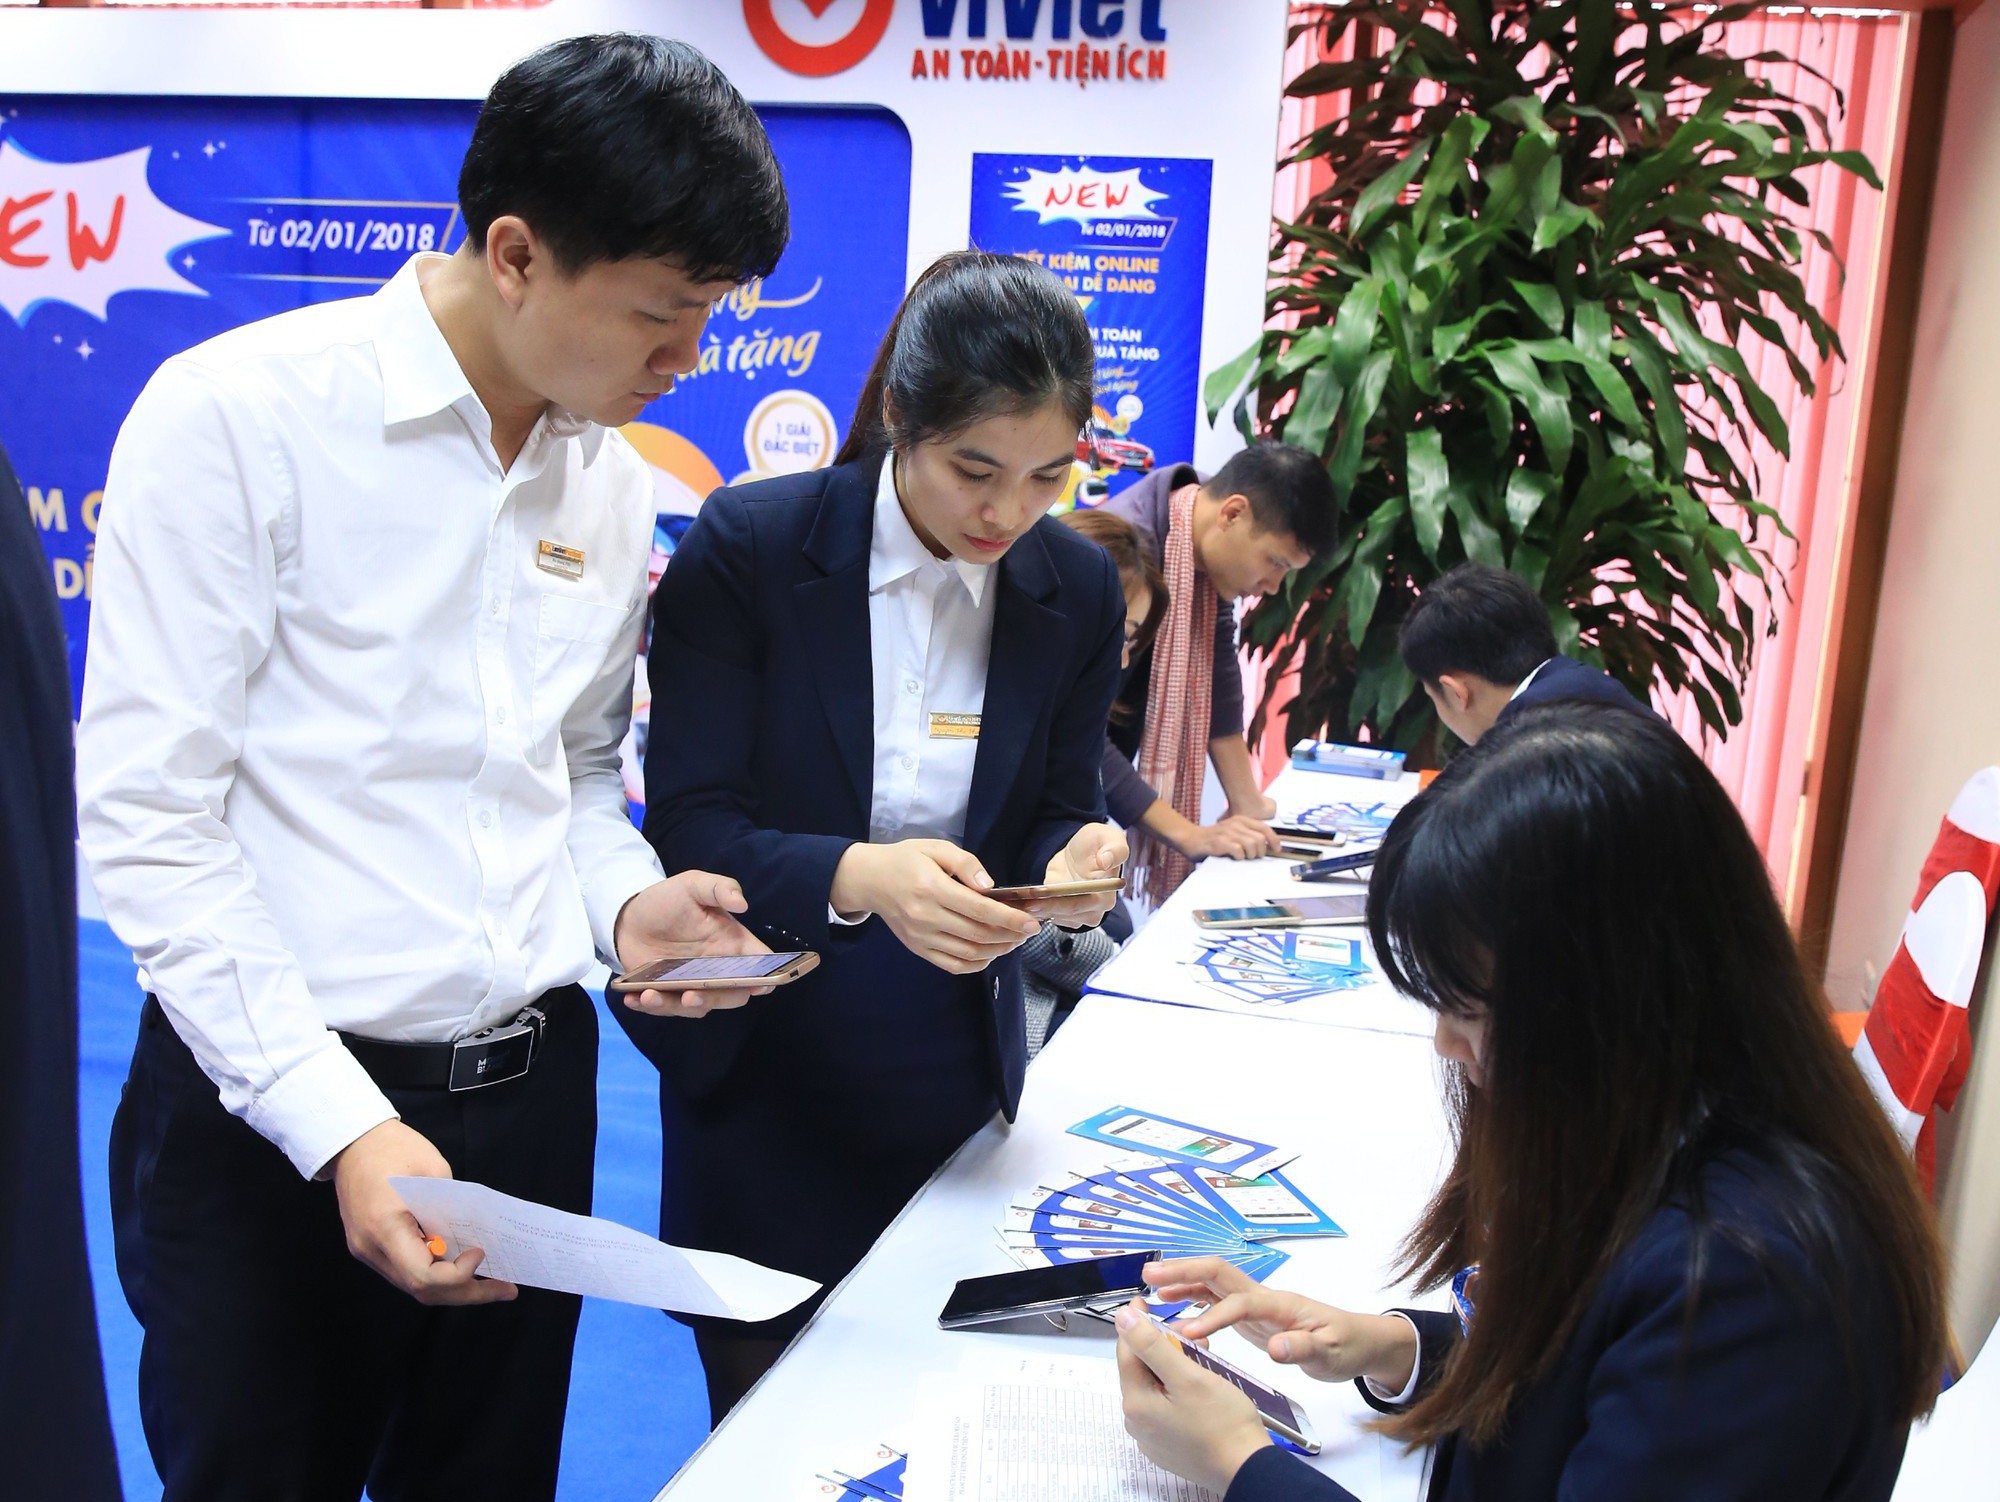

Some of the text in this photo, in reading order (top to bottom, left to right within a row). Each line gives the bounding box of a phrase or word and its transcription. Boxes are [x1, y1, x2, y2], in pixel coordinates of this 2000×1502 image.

[912, 49, 949, 79] AN
[1045, 182, 1129, 209] NEW
[280, 218, 436, 254] 02/01/2018
[1095, 223, 1167, 239] 02/01/2018
[1094, 256, 1160, 274] ONLINE
[726, 326, 822, 381] tặng
